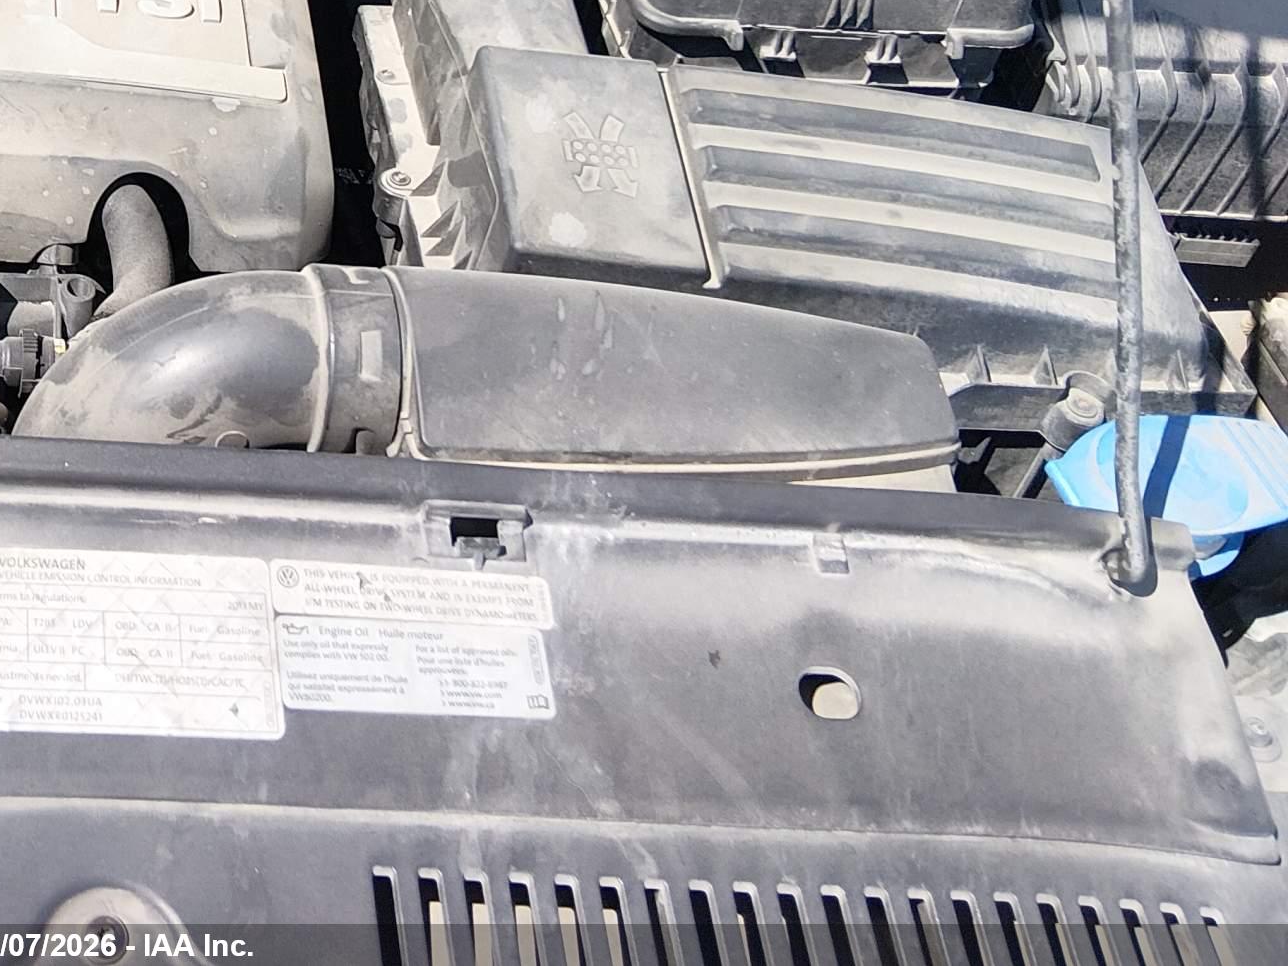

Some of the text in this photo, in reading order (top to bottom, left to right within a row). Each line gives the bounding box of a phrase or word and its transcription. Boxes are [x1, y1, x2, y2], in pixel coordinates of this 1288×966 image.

[39, 571, 86, 583] EMISSION
[87, 573, 131, 584] CONTROL
[134, 575, 203, 587] INFORMATION
[304, 567, 327, 580] THIS
[324, 599, 361, 611] TESTING
[363, 600, 377, 611] ON
[429, 590, 451, 602] AND
[505, 596, 535, 608] FROM
[216, 624, 262, 636] Gasoline
[318, 624, 443, 641] Engine Oil Huile moteur
[300, 640, 318, 651] only
[331, 640, 349, 650] that
[71, 645, 86, 656] PC
[148, 647, 163, 659] CA
[219, 650, 264, 663] Gasoline
[322, 650, 342, 660] with
[343, 651, 358, 661] VW
